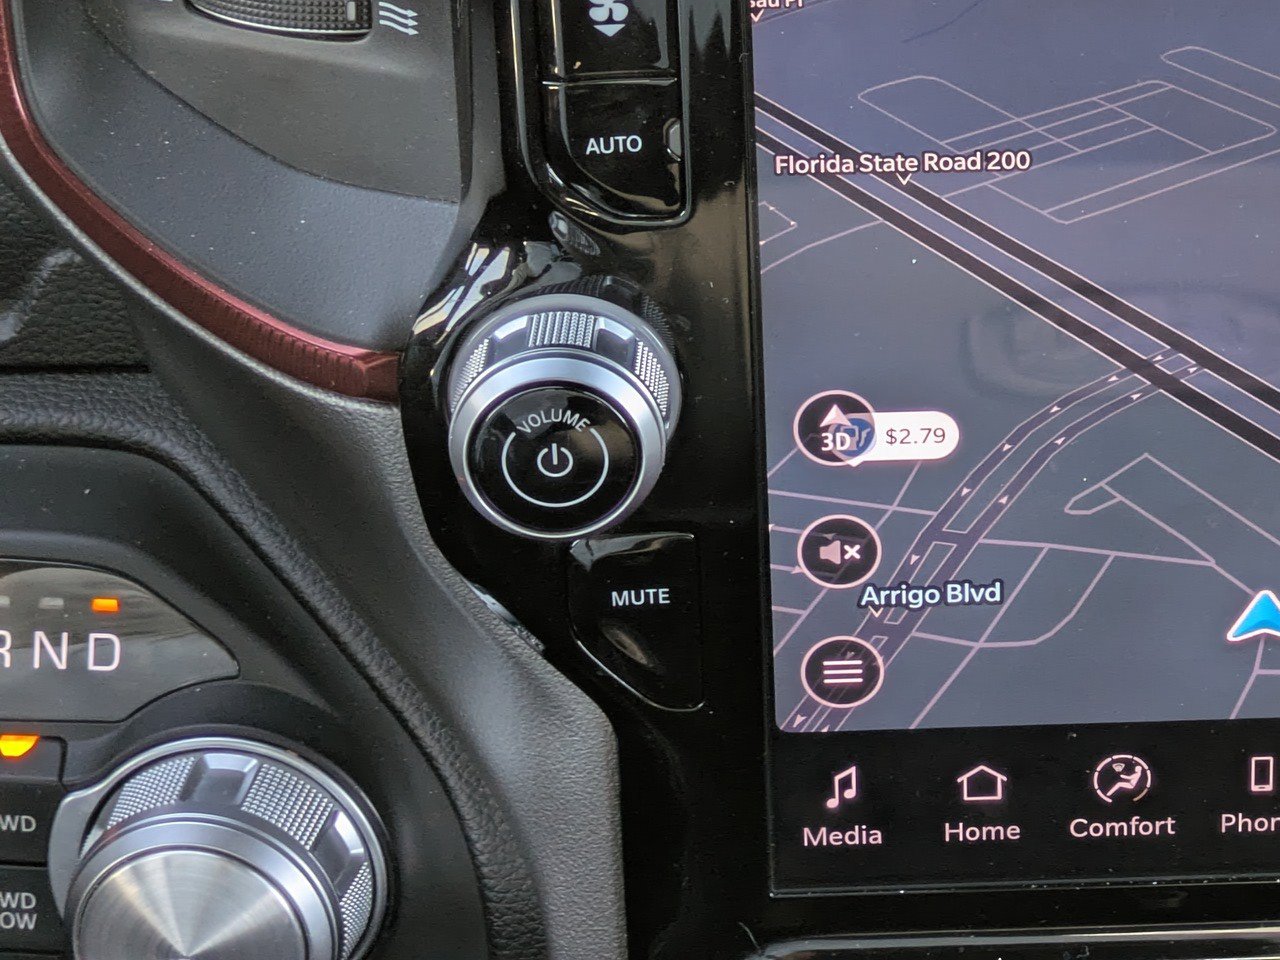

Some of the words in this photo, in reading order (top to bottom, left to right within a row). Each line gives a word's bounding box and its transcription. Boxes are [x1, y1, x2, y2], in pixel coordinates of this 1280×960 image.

[585, 134, 643, 155] AUTO
[775, 154, 855, 174] Florida
[859, 153, 918, 172] State
[924, 151, 981, 171] Road
[987, 151, 1031, 170] 200
[517, 408, 591, 432] VOLUME
[821, 431, 851, 451] 3D
[885, 427, 946, 446] $2.79
[611, 588, 671, 607] MUTE
[860, 585, 940, 609] Arrigo
[946, 581, 1001, 605] Blvd
[32, 630, 69, 670] N
[87, 632, 121, 672] D
[803, 824, 883, 847] Media
[944, 822, 1021, 842] Home
[1069, 815, 1176, 838] Comfort
